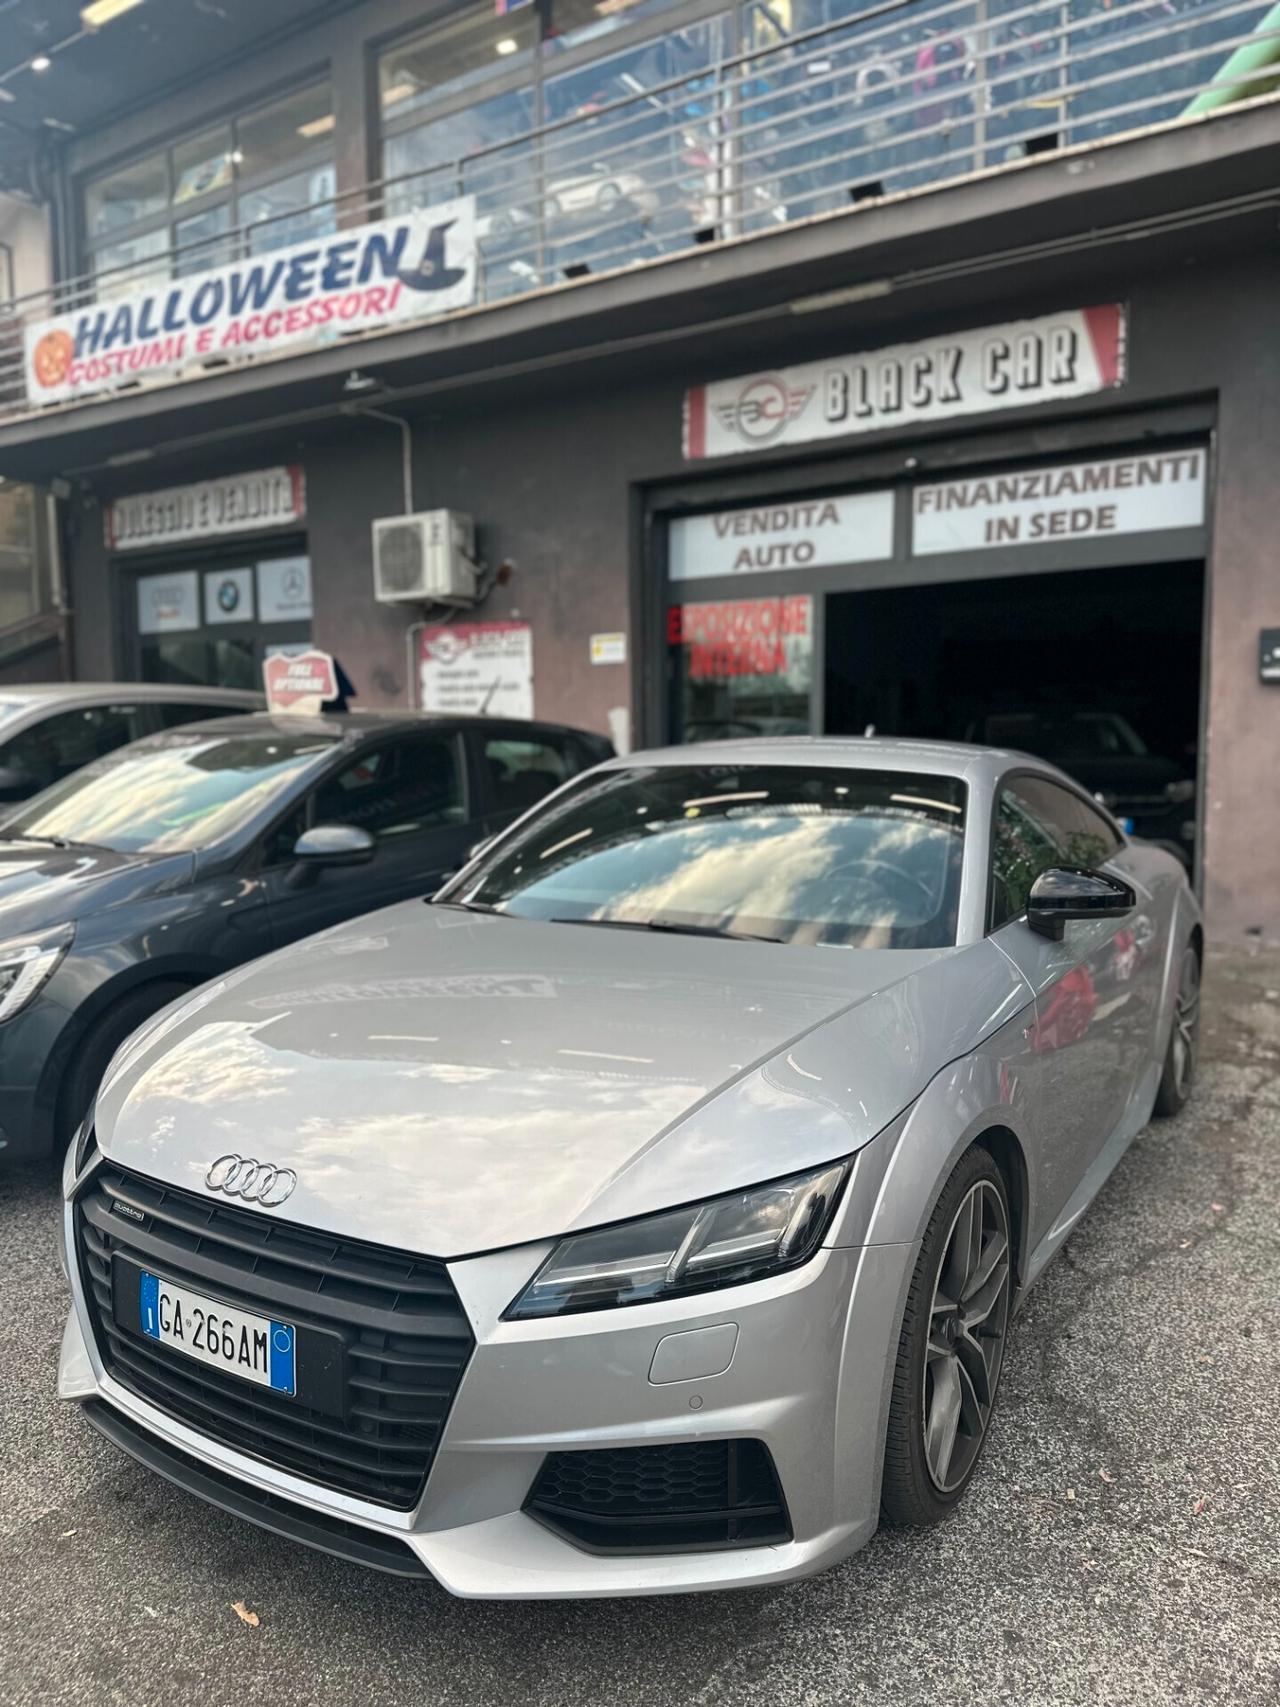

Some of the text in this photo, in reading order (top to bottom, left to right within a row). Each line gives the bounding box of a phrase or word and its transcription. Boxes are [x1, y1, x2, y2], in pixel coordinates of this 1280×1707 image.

[73, 226, 408, 358] HALLOWEEN
[68, 281, 402, 386] COSTUMI E ACCESSORI
[823, 325, 1079, 423] BLACK CAR
[916, 455, 1199, 515] FINANZIAMENTI
[713, 501, 840, 539] VENDITA
[984, 505, 1118, 543] IN SEDE
[732, 541, 816, 569] AUTO
